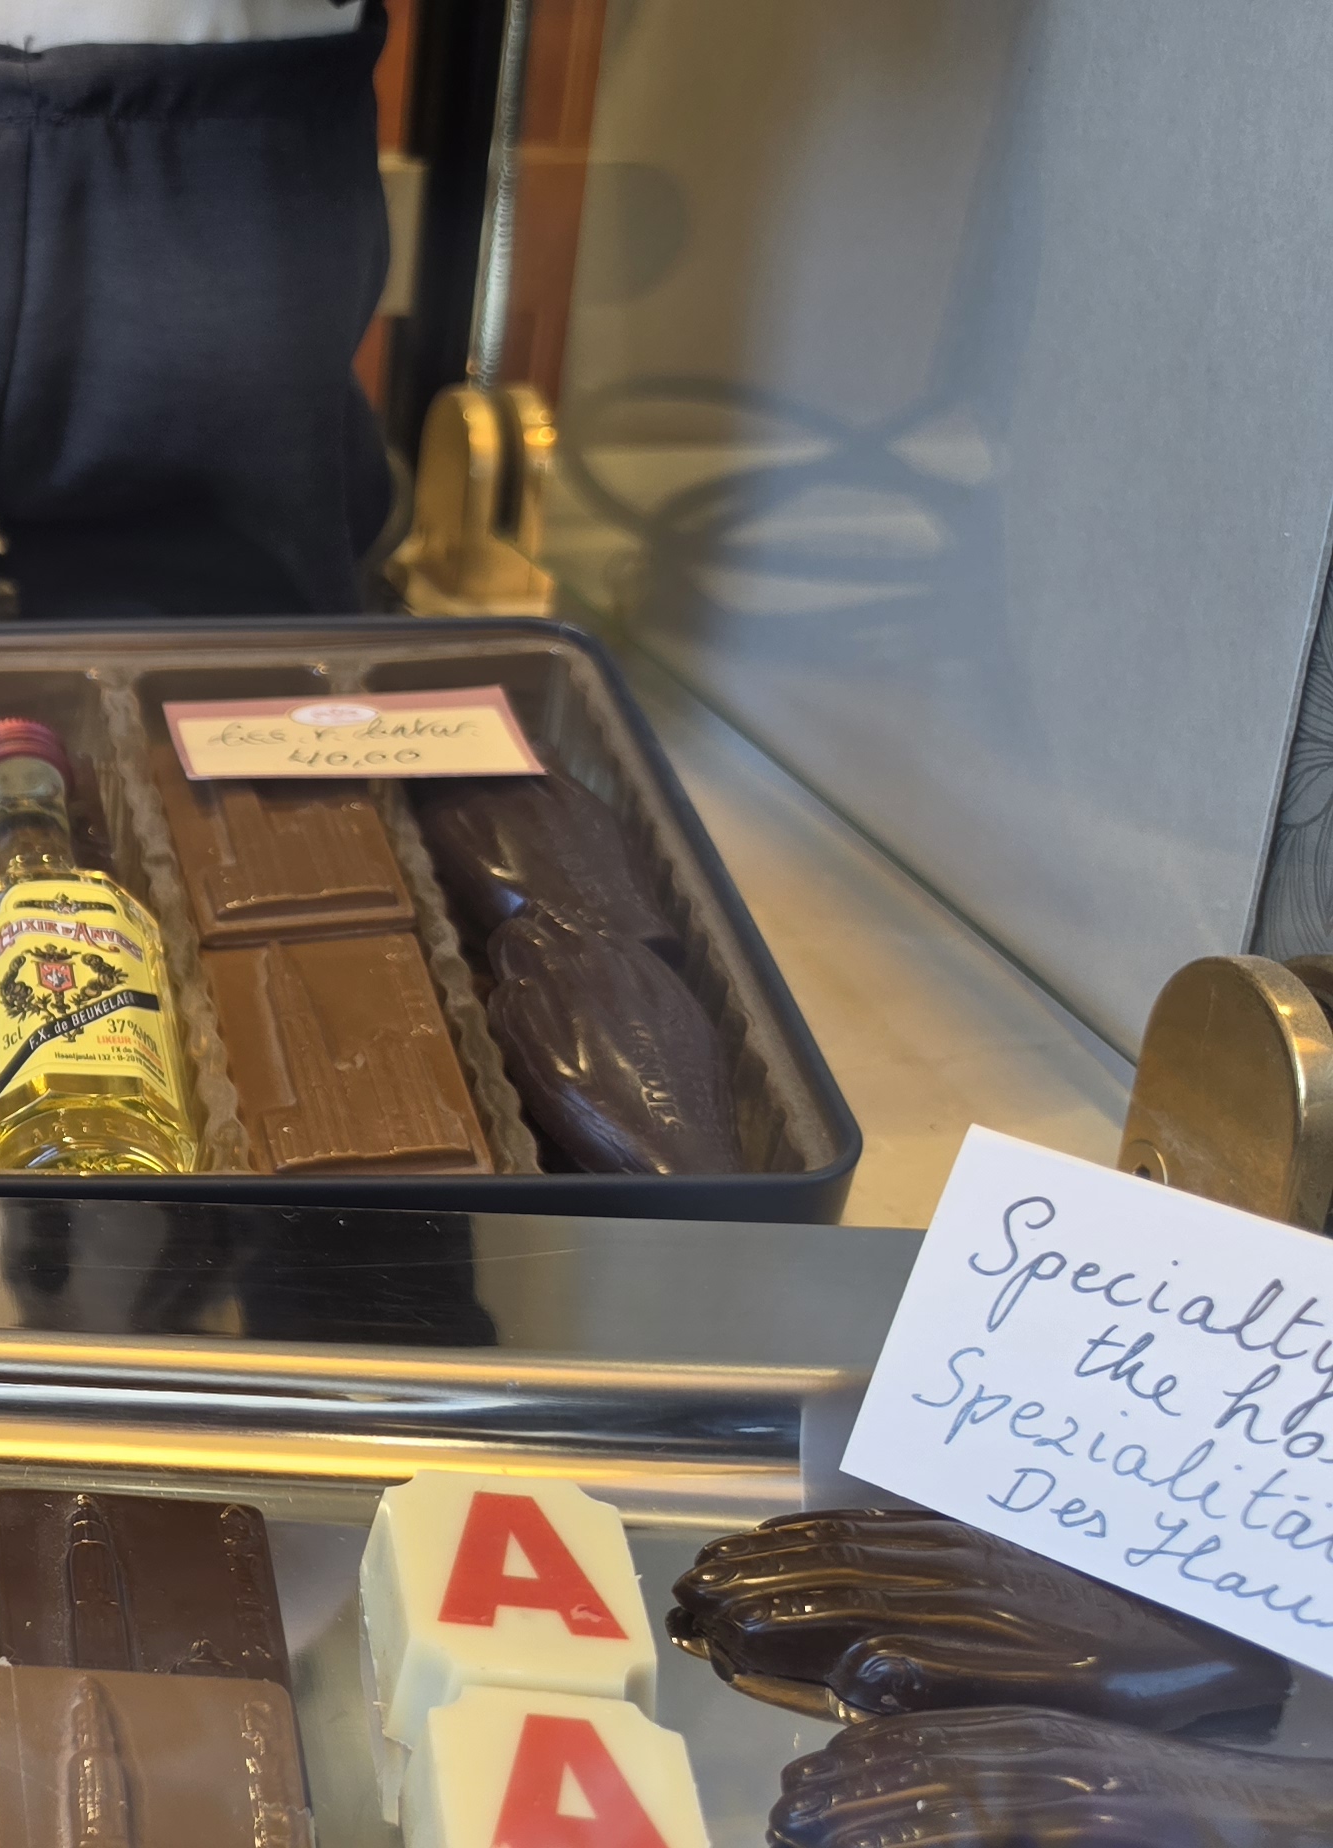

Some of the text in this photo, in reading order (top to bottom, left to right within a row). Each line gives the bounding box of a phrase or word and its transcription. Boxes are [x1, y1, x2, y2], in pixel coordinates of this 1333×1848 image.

[288, 747, 420, 769] 40,00
[1, 1024, 24, 1051] 3cl
[27, 1029, 52, 1051] F.X.
[53, 1017, 69, 1035] de
[96, 1034, 132, 1046] LIKEUR
[911, 1346, 1333, 1564] Spezialitä
[1074, 1324, 1333, 1464] the ho
[437, 1490, 630, 1641] A
[987, 1467, 1333, 1629] Des Hau
[488, 1713, 672, 1848] A
